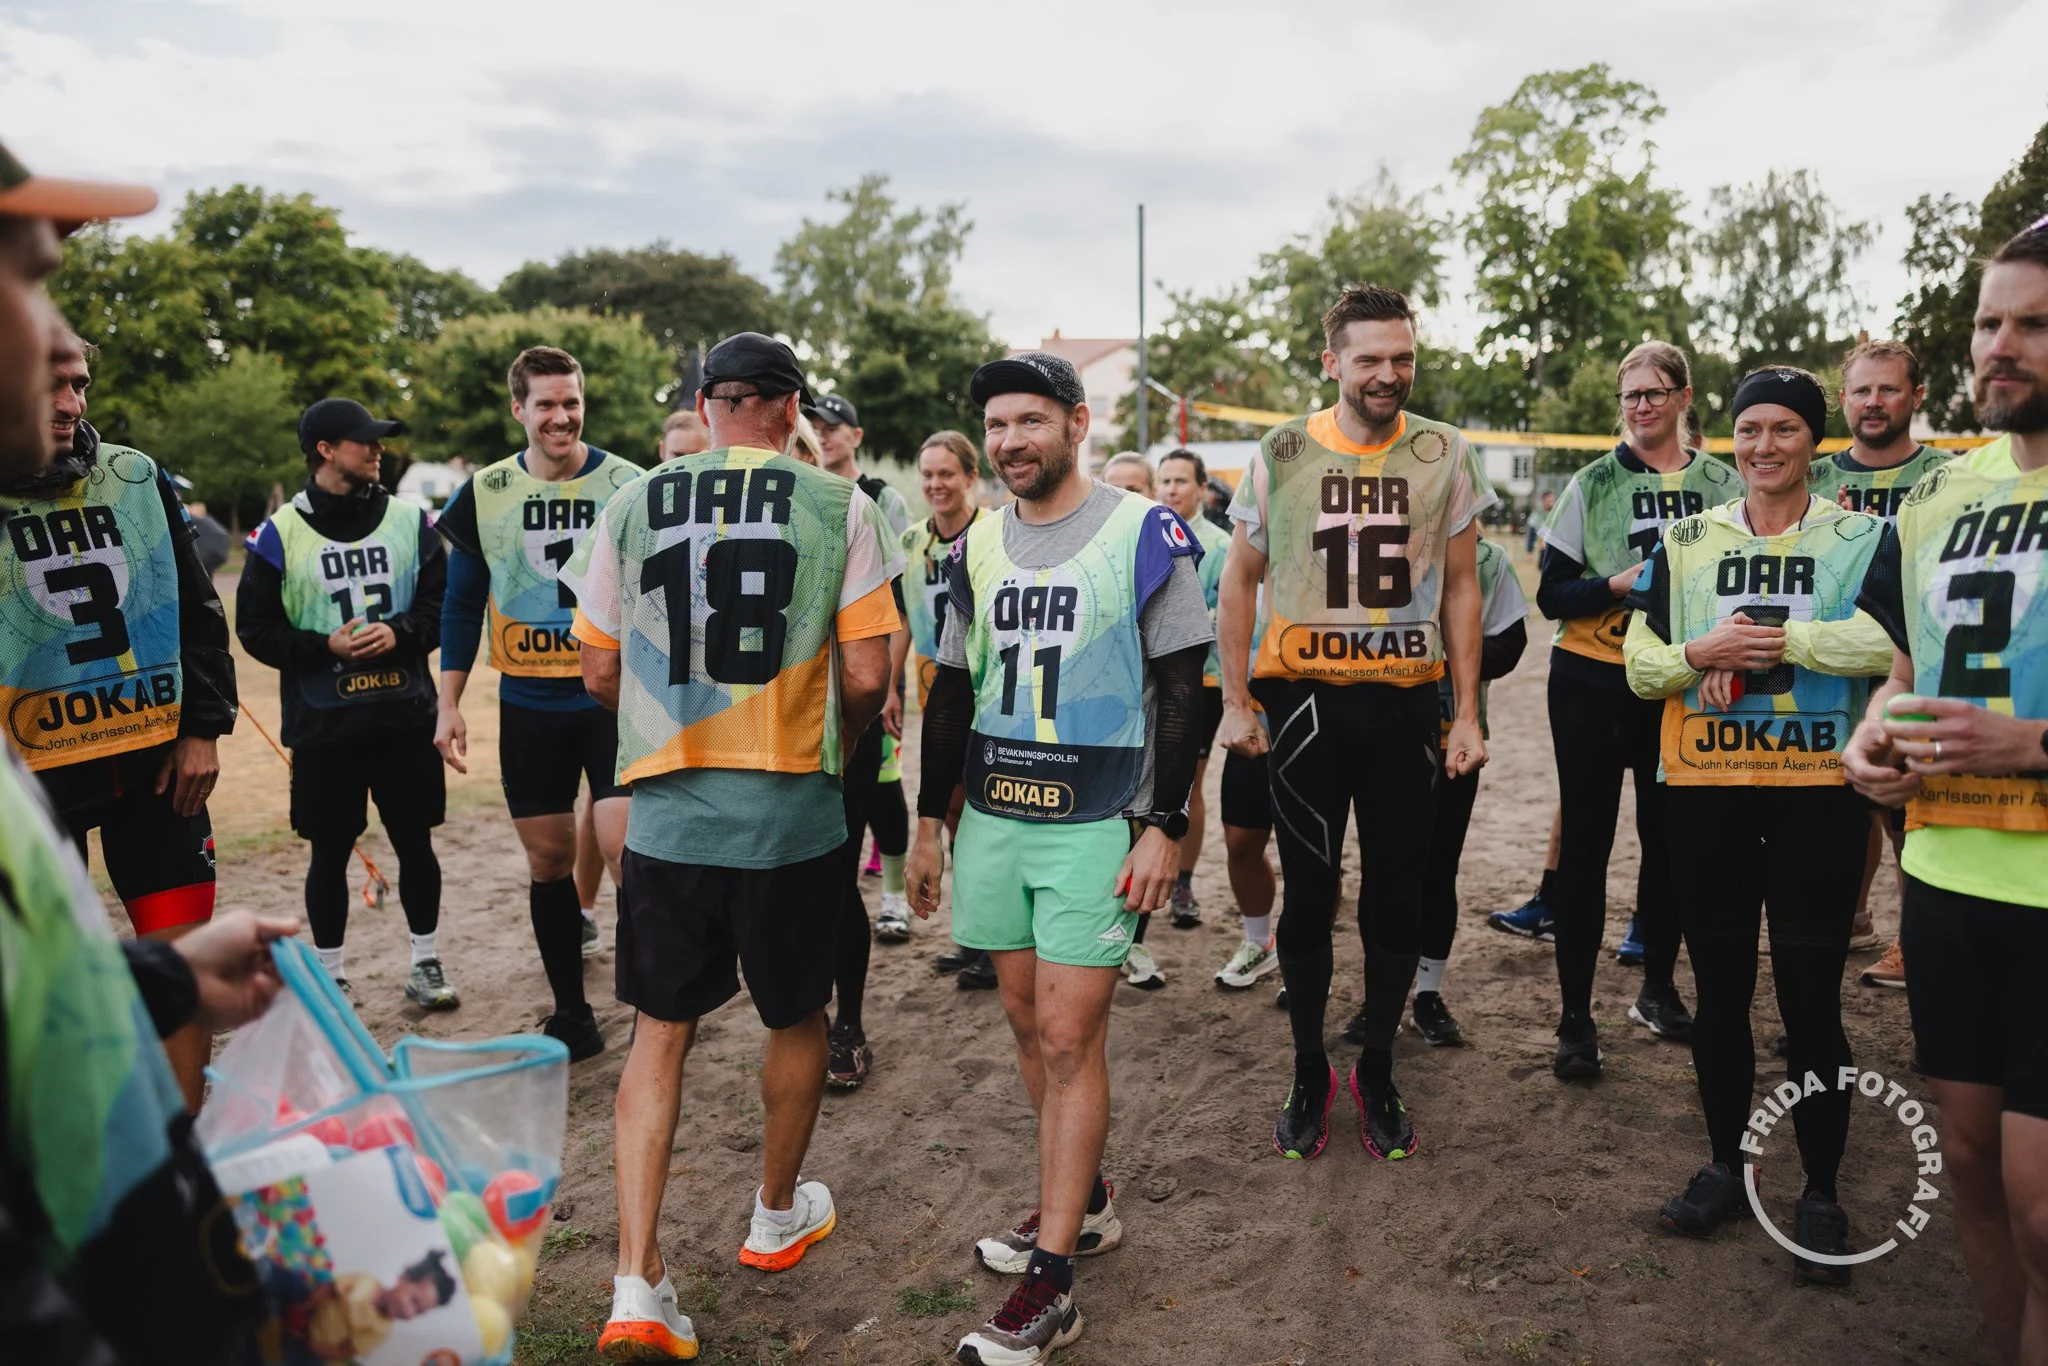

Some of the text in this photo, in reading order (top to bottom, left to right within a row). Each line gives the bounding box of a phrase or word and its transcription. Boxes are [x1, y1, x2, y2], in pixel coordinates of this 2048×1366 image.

[523, 494, 596, 531] ÖAR
[647, 465, 797, 532] ÖAR
[1320, 469, 1410, 515] ÖAR
[6, 506, 124, 563] ÖAR
[321, 546, 389, 581] ÖAR
[1312, 523, 1413, 610] 16
[1716, 550, 1815, 597] ÖAR
[43, 562, 131, 666] 3
[331, 583, 393, 627] 12
[640, 536, 798, 688] 18
[994, 579, 1078, 632] ÖAR
[517, 627, 581, 653] JOK
[1297, 629, 1428, 661] JOKAB
[1937, 570, 2016, 698] 2
[346, 672, 401, 693] JOKAB
[1000, 642, 1063, 721] 11
[1330, 667, 1379, 677] Karlsson
[1382, 665, 1411, 677] Åkeri
[1412, 663, 1429, 675] AB
[38, 673, 177, 732] JOKAB
[45, 737, 78, 751] John
[80, 722, 141, 746] Karlsson
[997, 746, 1079, 763] BEVAKNINGSPOOLEN
[1695, 719, 1837, 753] JOKAB
[1697, 757, 1838, 771] John Karlsson Åkeri AB
[991, 780, 1061, 808] JOKAB
